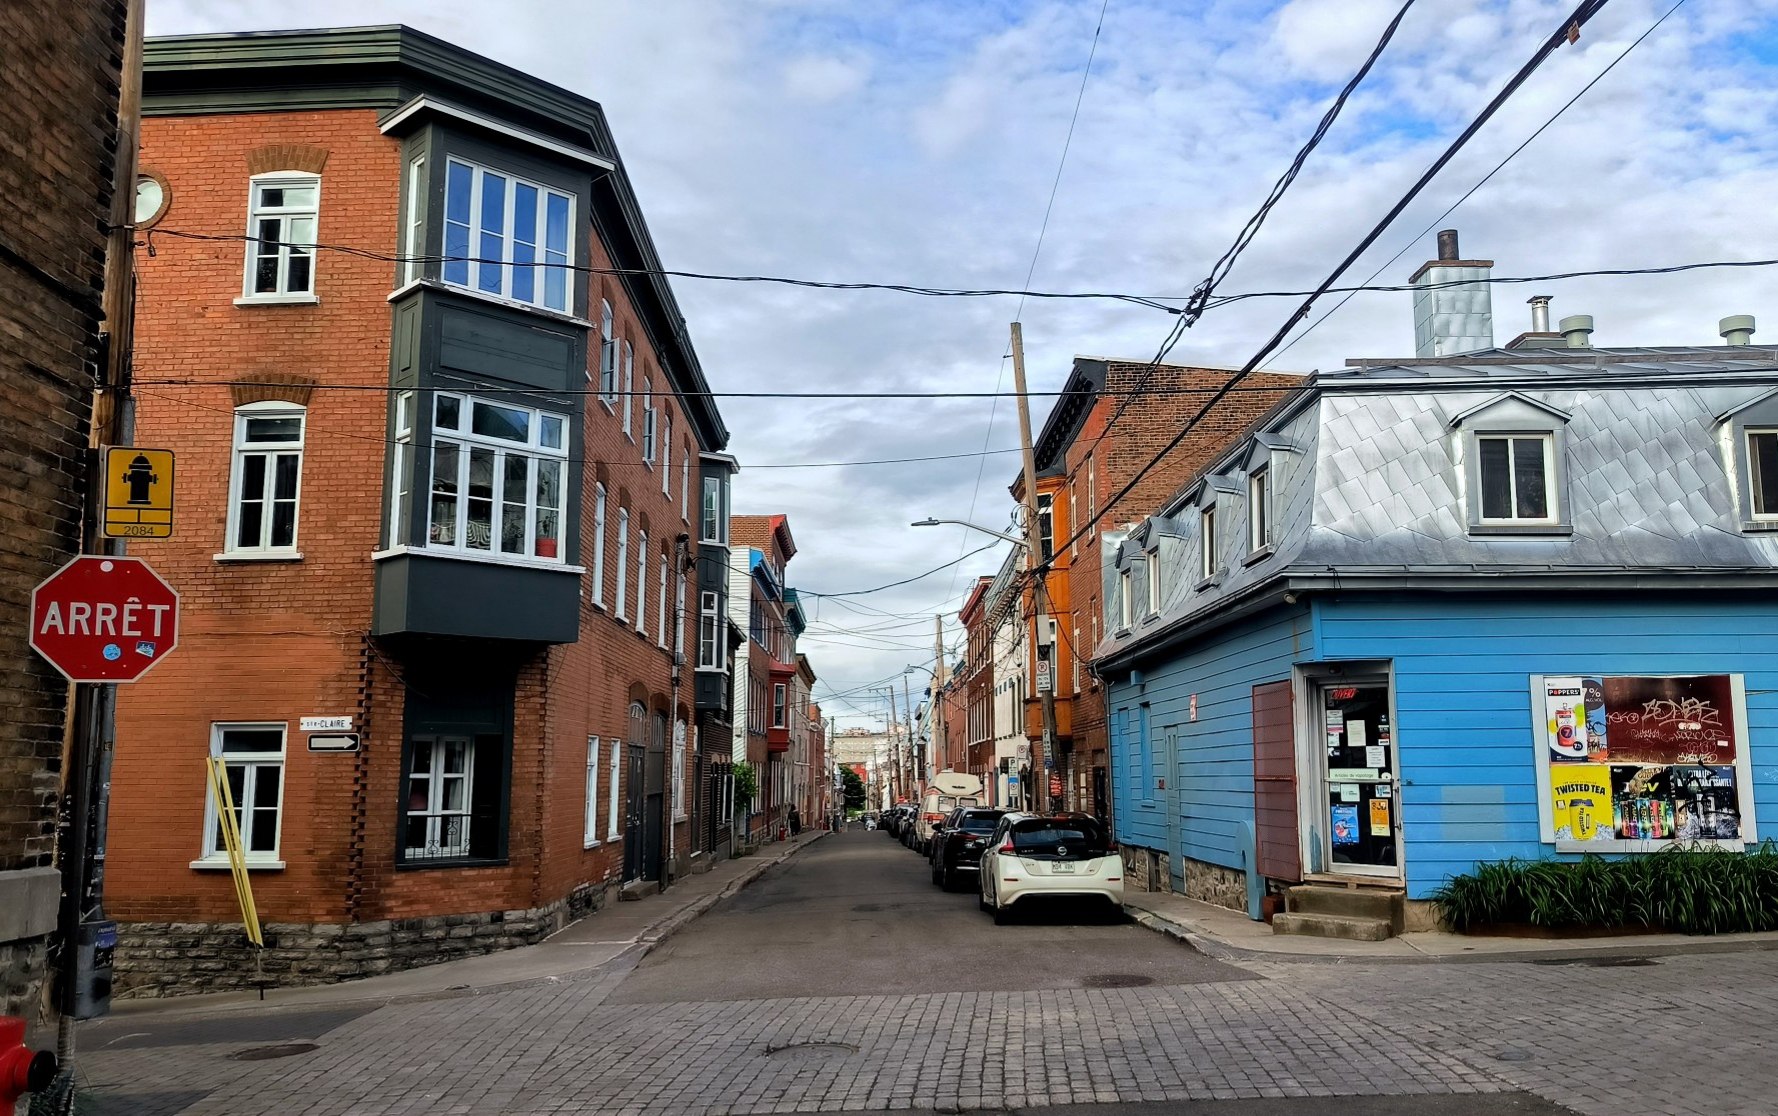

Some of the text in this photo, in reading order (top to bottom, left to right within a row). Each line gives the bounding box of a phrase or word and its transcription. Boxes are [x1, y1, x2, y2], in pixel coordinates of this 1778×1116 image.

[123, 524, 155, 536] 2084
[40, 597, 170, 637] ARRÊT
[1555, 783, 1606, 795] TWISTED TEA
